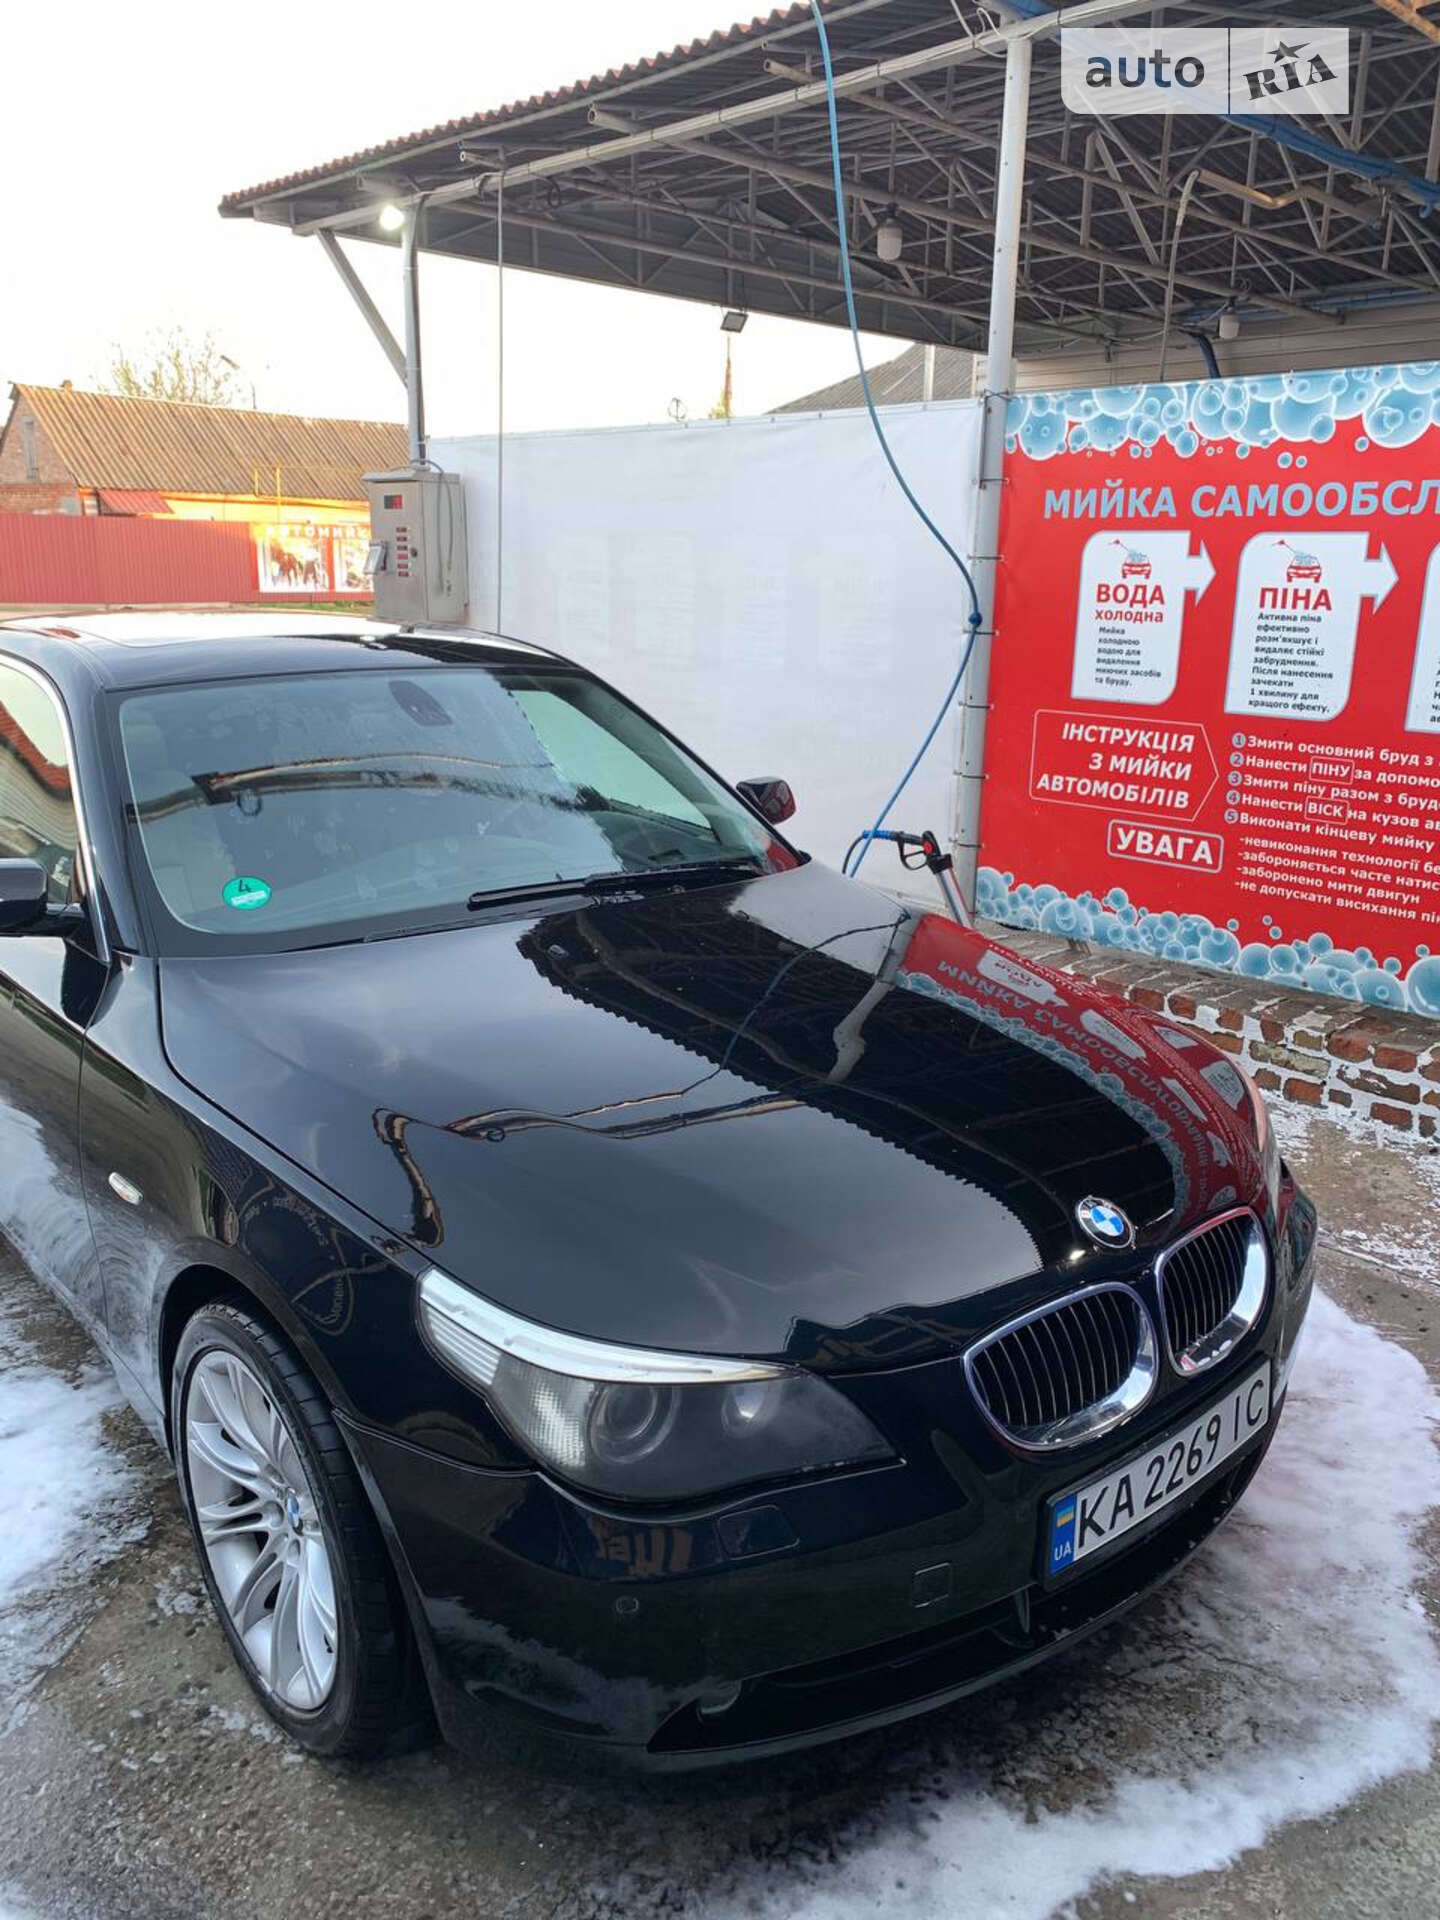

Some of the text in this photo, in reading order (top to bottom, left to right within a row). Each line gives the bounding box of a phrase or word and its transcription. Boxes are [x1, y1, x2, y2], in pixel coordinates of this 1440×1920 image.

[1043, 479, 1177, 519] МИЙКА
[1097, 584, 1164, 607] ВОДА
[1259, 587, 1332, 611] ПІНА
[1095, 609, 1163, 623] холодна
[1257, 624, 1310, 634] ефективно
[1258, 612, 1322, 623] Активна піна
[1297, 647, 1325, 656] стійкі
[1251, 678, 1294, 687] зачекати
[1252, 666, 1333, 679] Після нанесення
[1248, 700, 1289, 711] кращого
[1258, 690, 1298, 700] хвилину
[1300, 692, 1319, 700] для
[1062, 723, 1194, 753] ІНСТРУКЦІЯ
[1247, 736, 1293, 750] Змити
[1298, 743, 1374, 759] основний
[1379, 749, 1420, 766] бруд
[1424, 757, 1434, 766] з
[1109, 755, 1192, 781] МИЙКИ
[1245, 756, 1307, 773] Нанести
[1312, 762, 1350, 778] ПІНУ
[1354, 769, 1371, 780] за
[1036, 774, 1189, 808] АВТОМОБІЛІВ
[1243, 774, 1289, 790] Змити
[1293, 781, 1326, 798] піну
[1331, 787, 1379, 802] разом
[1384, 794, 1392, 803] з
[1242, 794, 1303, 811] Нанести
[1307, 802, 1343, 817] ВІСК
[1347, 810, 1367, 821] на
[1372, 813, 1419, 828] кузов
[1117, 828, 1212, 864] УВАГА
[1240, 813, 1310, 833] Виконати
[1315, 824, 1377, 844] кінцеву
[1382, 836, 1435, 853] мийку
[1238, 851, 1346, 875] -забороняється
[1351, 868, 1392, 883] часте
[1239, 836, 1337, 858] -невиконання
[1341, 851, 1420, 871] технології
[1237, 866, 1420, 904] -заборонено мити двигун
[1234, 880, 1257, 892] -не
[1260, 885, 1332, 904] допускати
[1336, 898, 1416, 920] висихання
[1078, 1379, 1264, 1549] KA 2269 IC
[1054, 1547, 1073, 1561] UA
